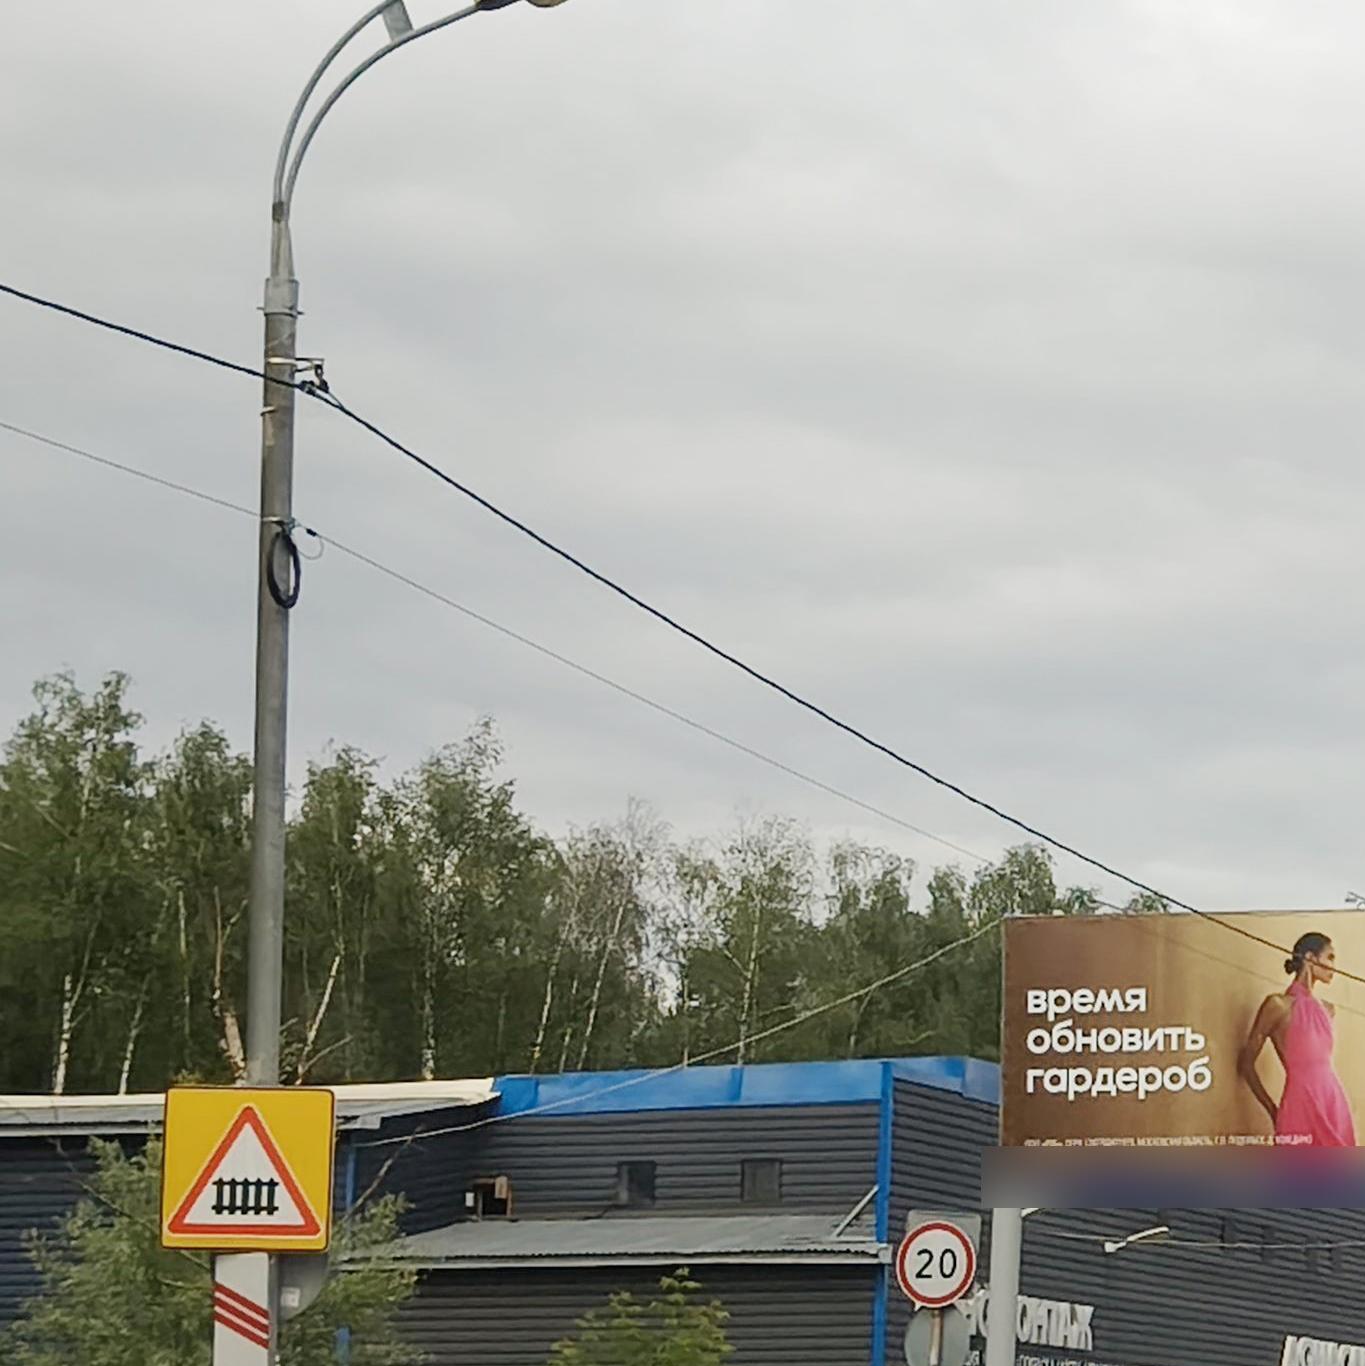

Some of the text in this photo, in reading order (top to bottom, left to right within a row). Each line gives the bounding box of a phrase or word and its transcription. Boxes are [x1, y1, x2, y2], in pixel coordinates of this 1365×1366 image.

[1026, 987, 1147, 1022] время
[1026, 1018, 1206, 1054] обновить
[1026, 1055, 1212, 1101] гардероб
[915, 1248, 958, 1279] 20
